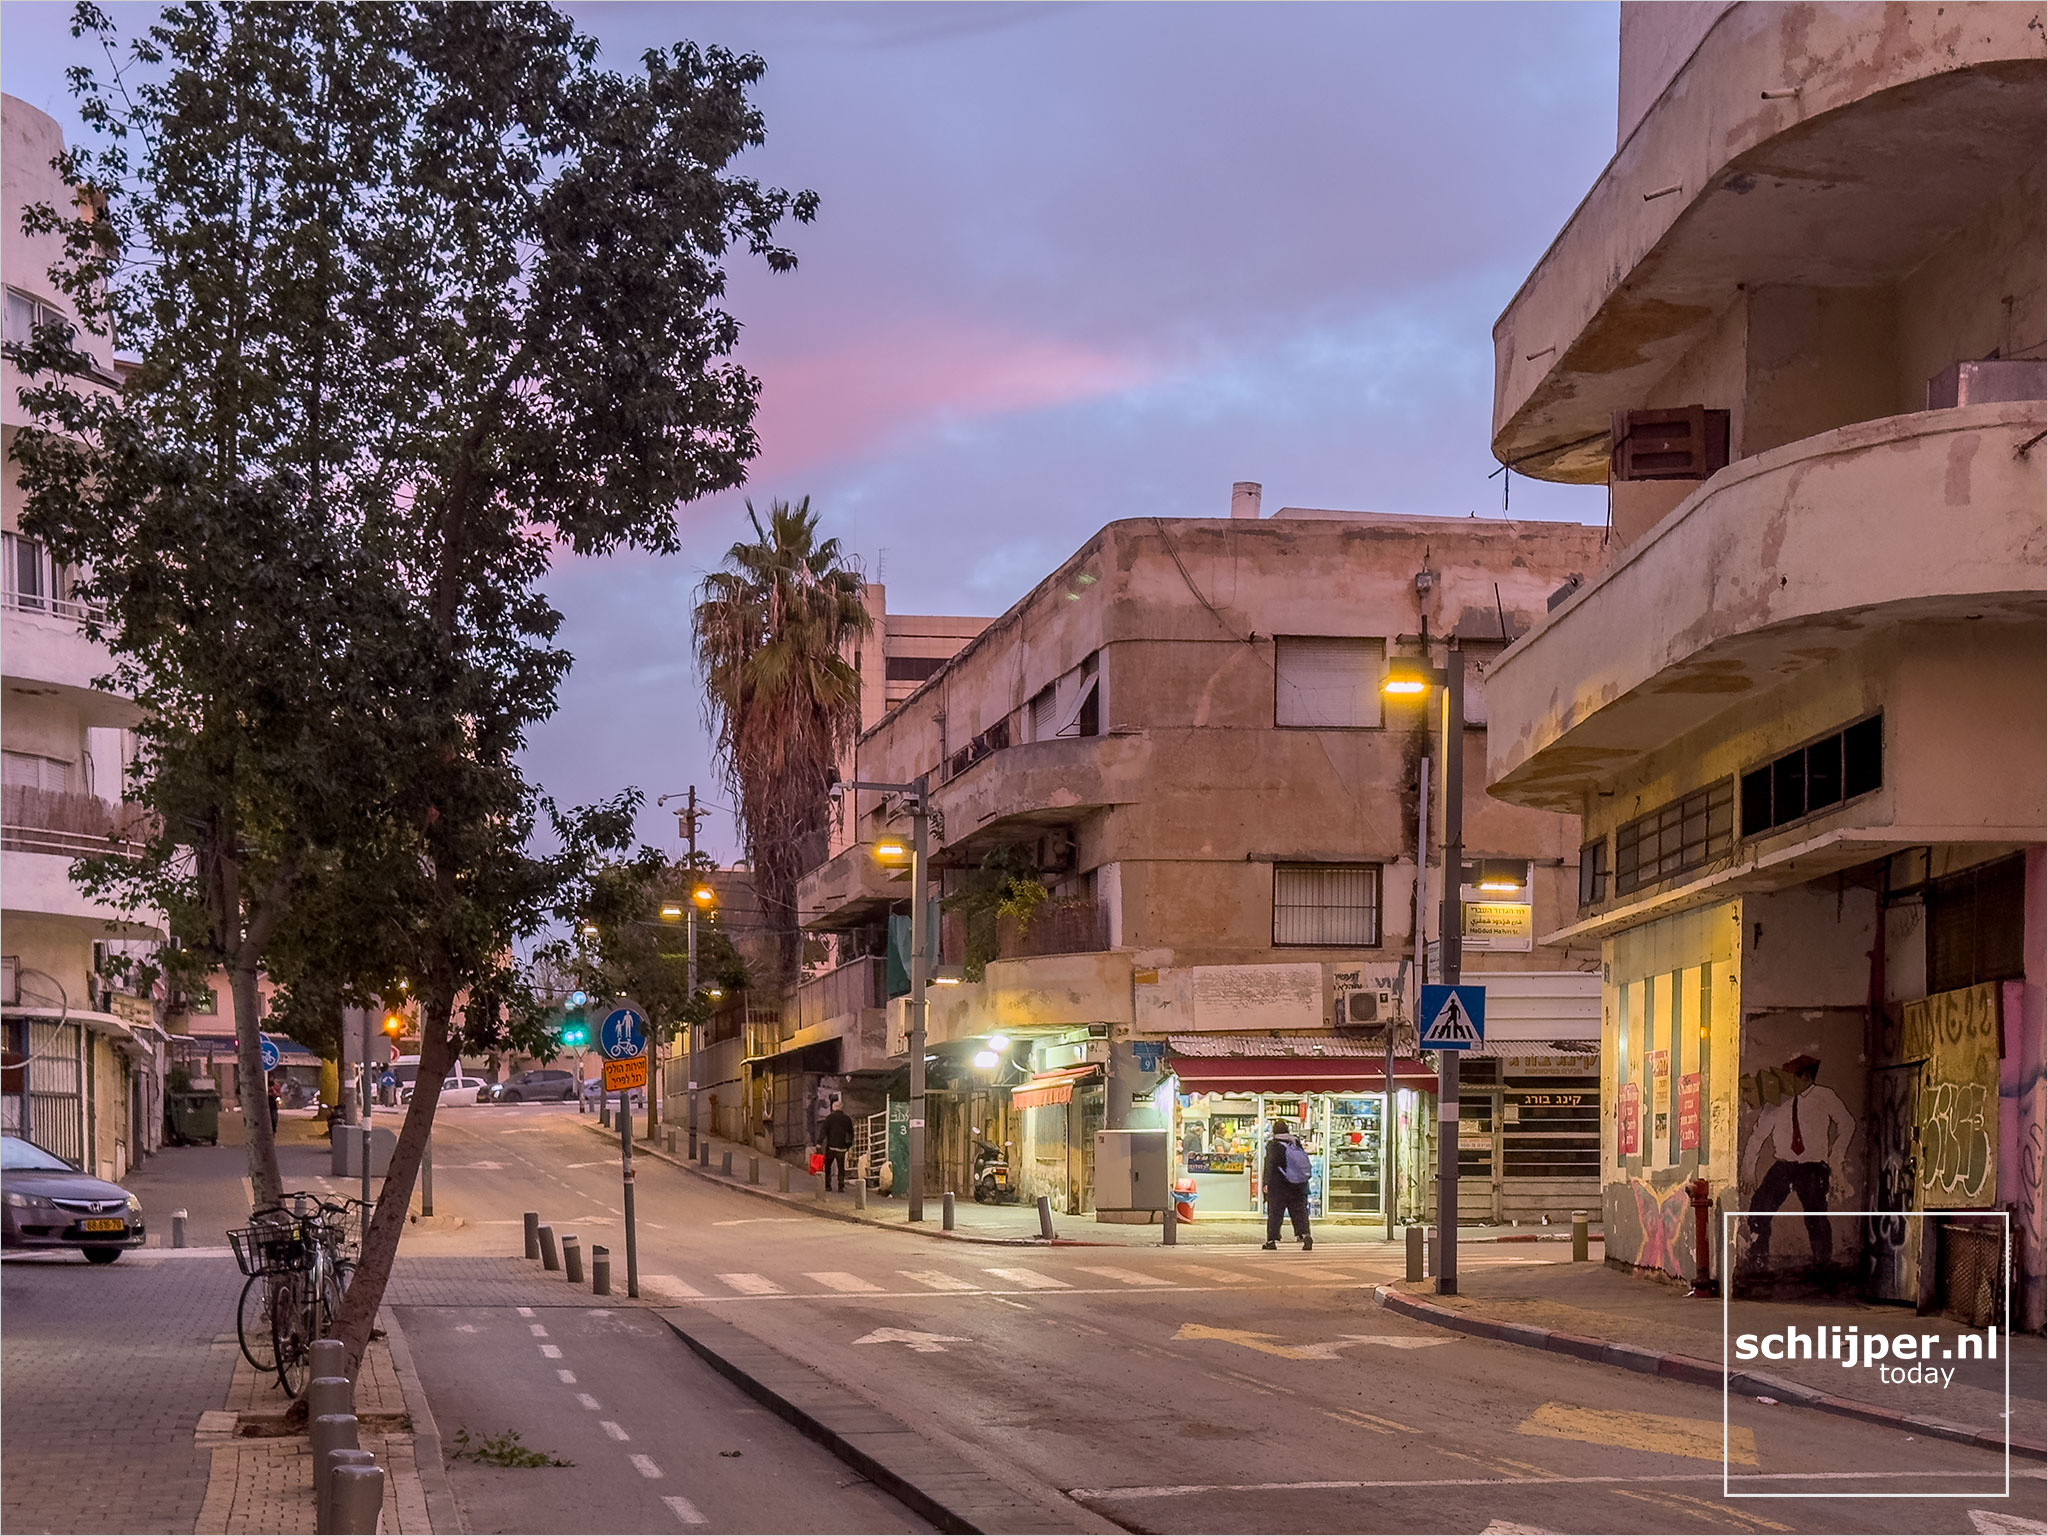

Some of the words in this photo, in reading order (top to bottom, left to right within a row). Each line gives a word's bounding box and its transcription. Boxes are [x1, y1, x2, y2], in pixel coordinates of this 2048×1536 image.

[606, 1064, 624, 1074] הולכי
[1525, 1095, 1551, 1104] בורג
[1556, 1095, 1582, 1106] קינג
